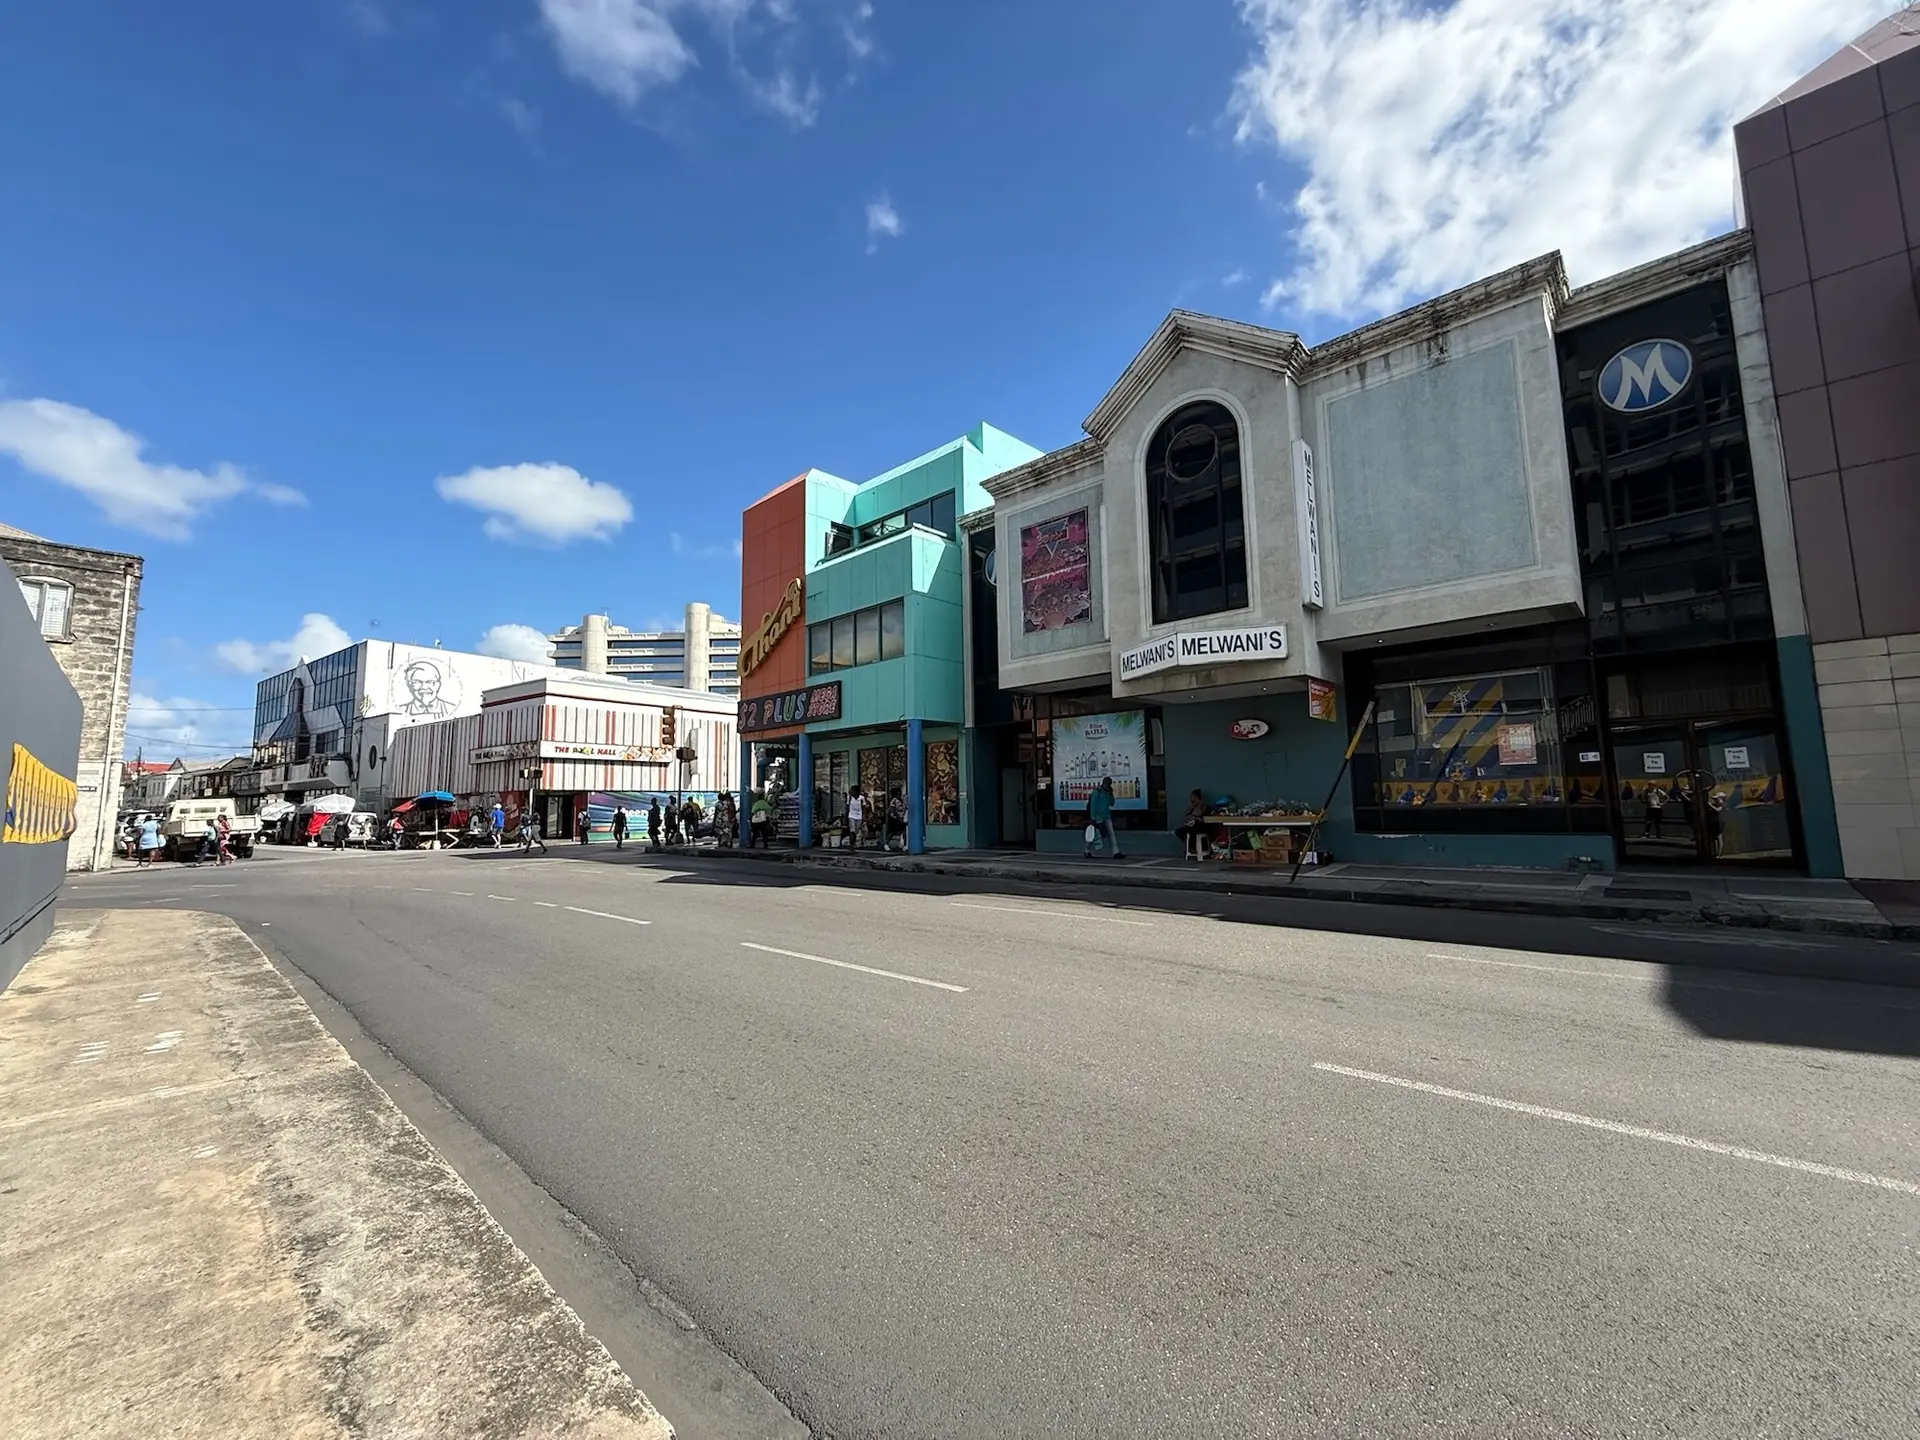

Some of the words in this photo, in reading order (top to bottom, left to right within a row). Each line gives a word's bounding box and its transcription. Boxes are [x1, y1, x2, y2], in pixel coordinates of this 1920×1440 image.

[1303, 449, 1321, 599] MELWANI'S
[1121, 640, 1175, 674] MELWANI'S
[1181, 630, 1283, 657] MELWANI'S
[738, 702, 758, 731] $2
[763, 691, 807, 725] PLUS
[806, 699, 837, 718] STORE
[597, 748, 616, 756] HALL
